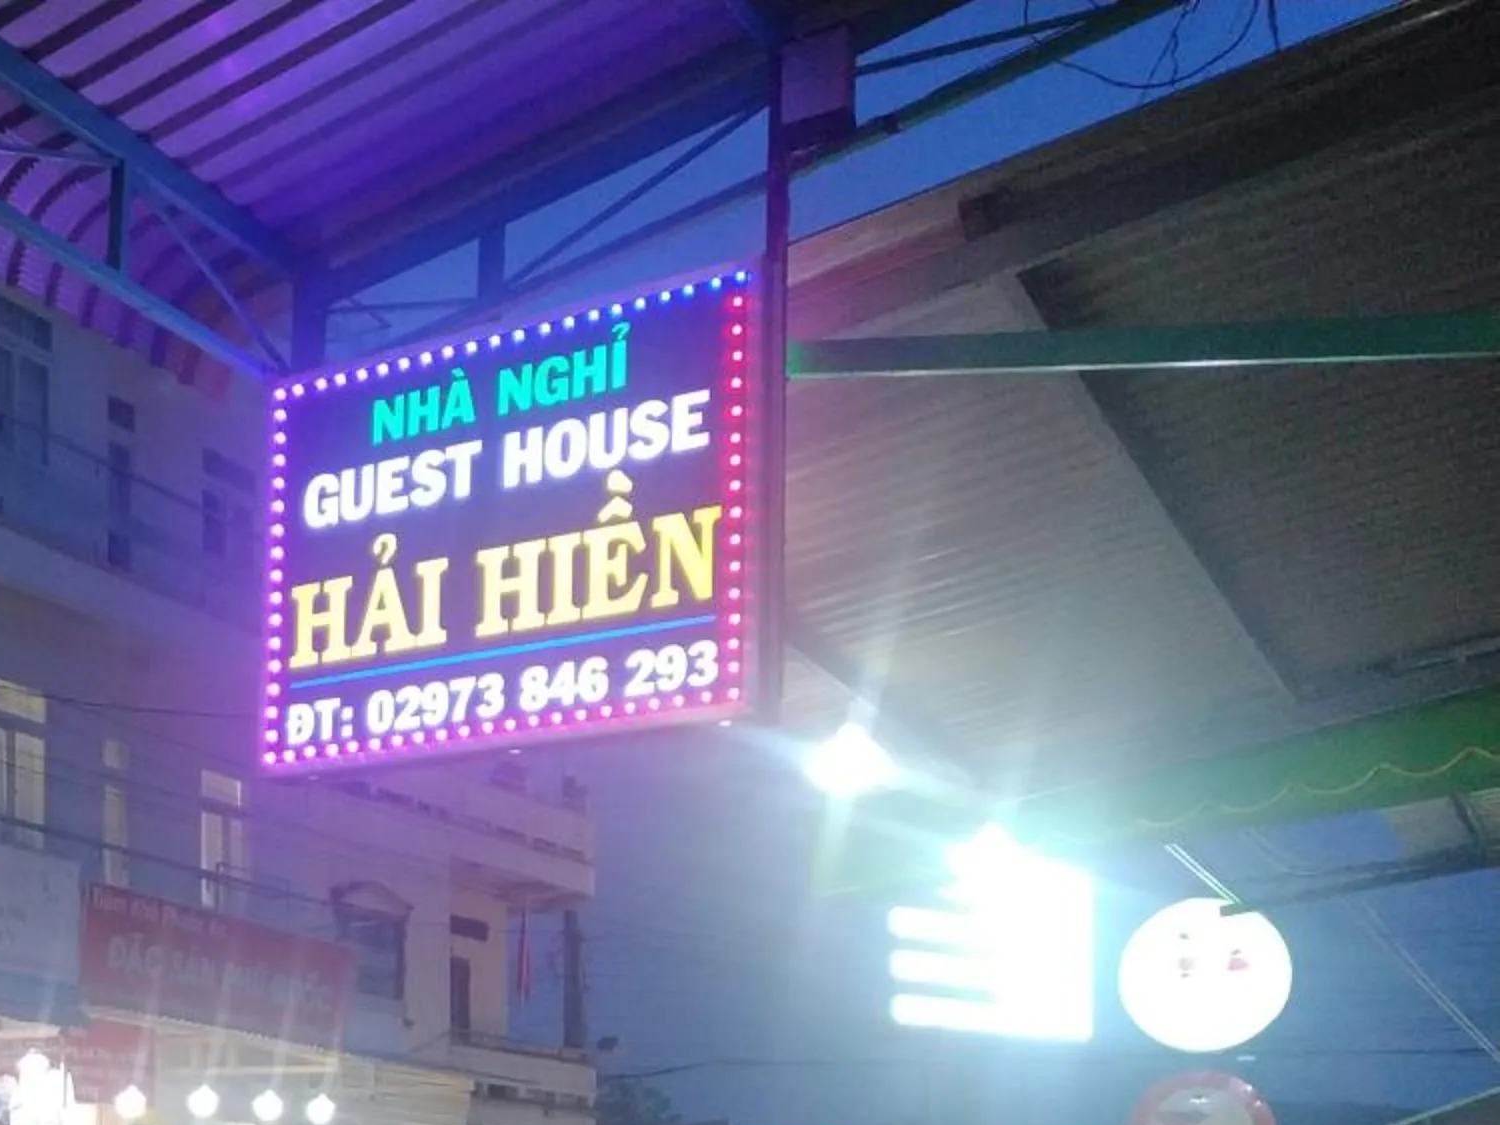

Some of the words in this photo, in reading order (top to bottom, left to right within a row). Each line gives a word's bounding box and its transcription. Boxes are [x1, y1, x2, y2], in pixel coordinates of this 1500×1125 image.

[372, 368, 476, 445] NHÀ
[497, 323, 631, 417] NGHỈ
[303, 439, 483, 529] GUEST
[503, 389, 711, 488] HOUSE
[289, 533, 449, 669] HẢI
[474, 469, 722, 638] HIỀN
[286, 696, 354, 745] ĐT:
[367, 674, 505, 733] 02973
[519, 656, 609, 712] 846
[625, 641, 719, 697] 293
